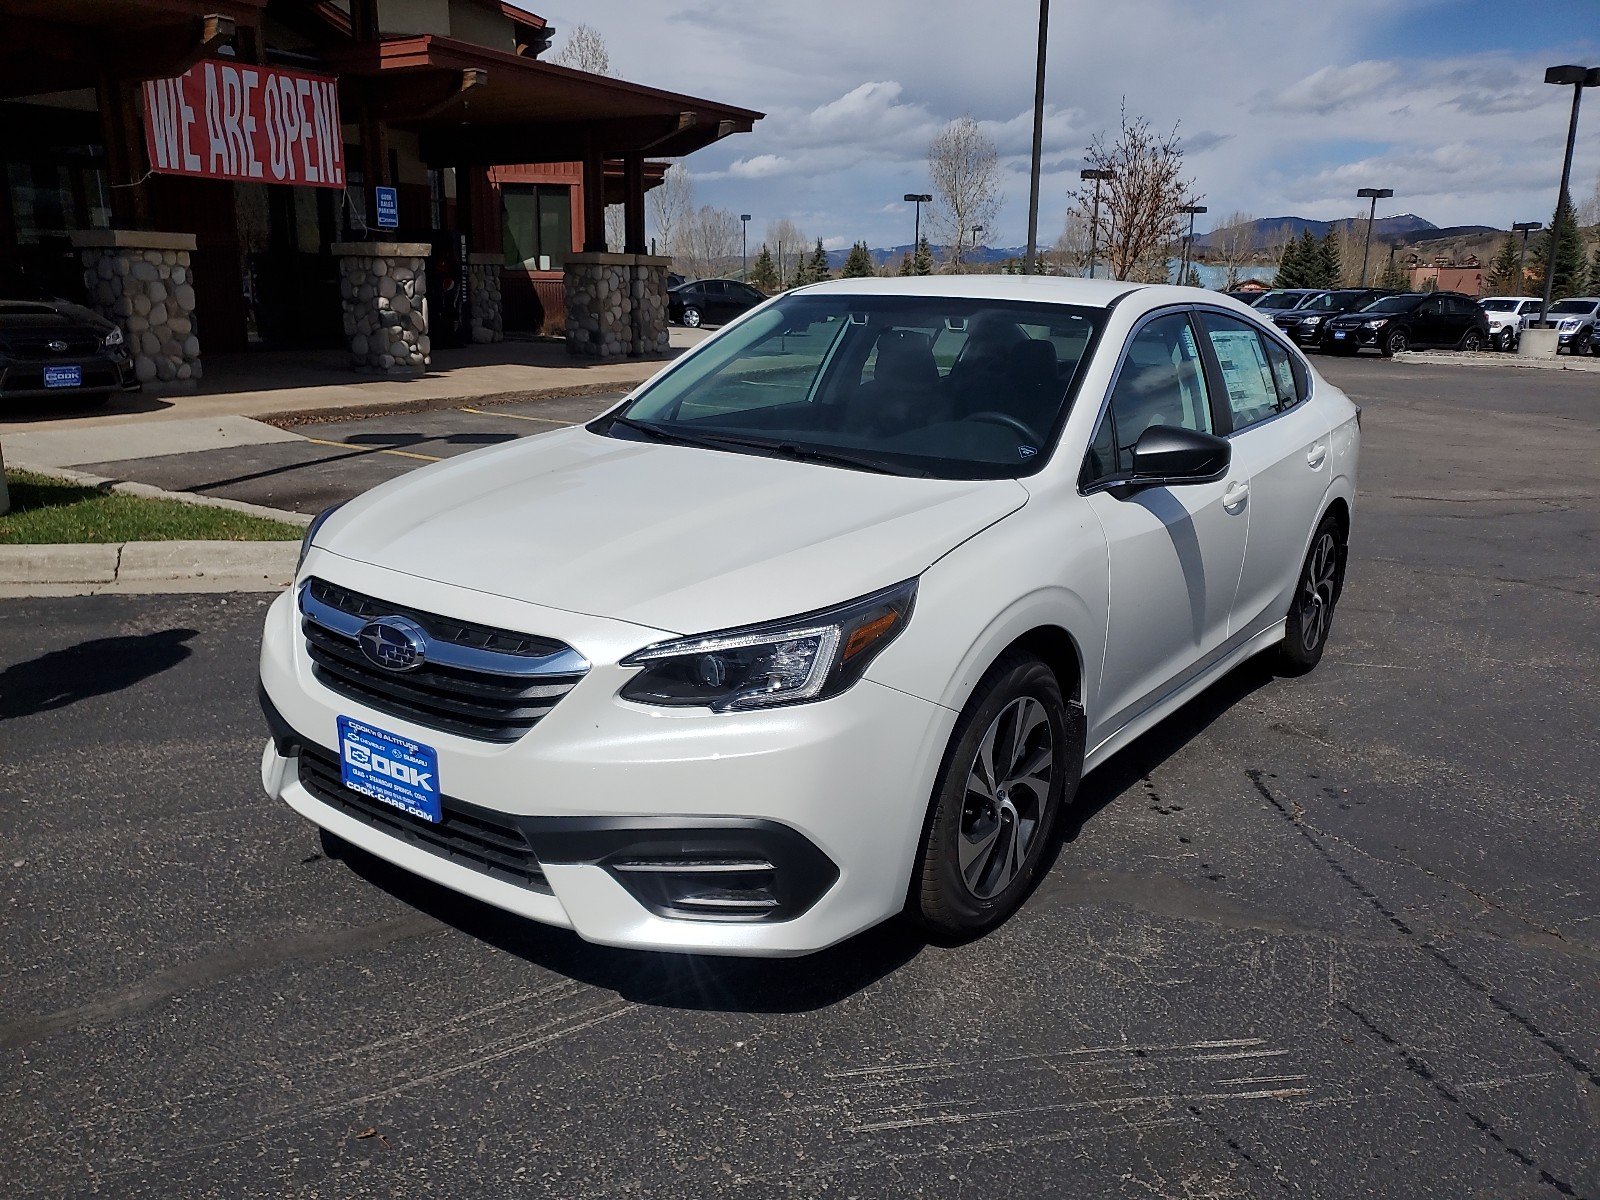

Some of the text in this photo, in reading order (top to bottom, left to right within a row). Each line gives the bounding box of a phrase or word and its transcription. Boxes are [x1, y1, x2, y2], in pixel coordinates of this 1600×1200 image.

[147, 63, 342, 184] WE ARE OPEN!
[45, 372, 79, 380] COOK
[359, 737, 386, 751] CHEVROLET
[383, 734, 419, 752] ALTITUDE
[343, 739, 434, 792] COOK
[403, 754, 428, 767] SUBARU
